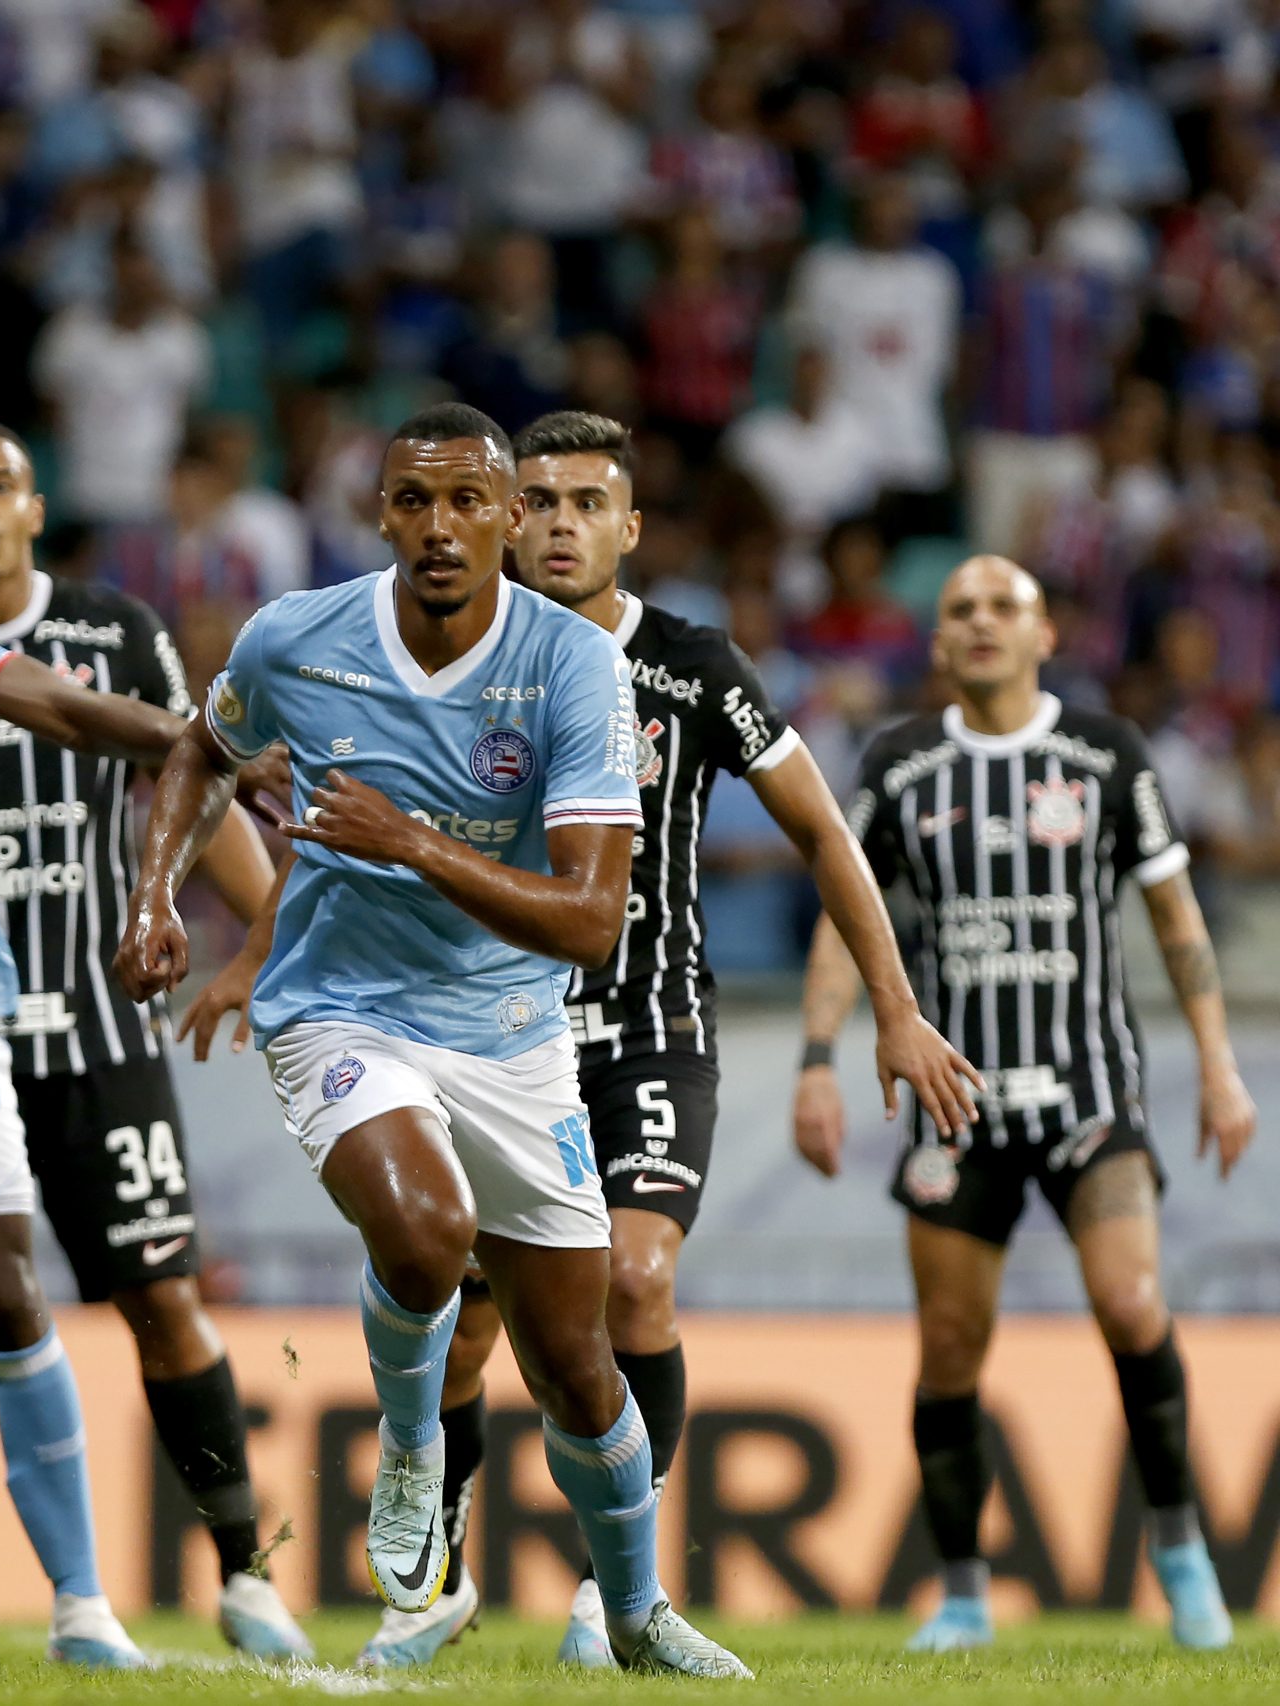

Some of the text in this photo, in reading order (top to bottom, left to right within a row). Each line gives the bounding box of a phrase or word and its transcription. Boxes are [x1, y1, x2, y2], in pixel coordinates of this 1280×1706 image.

[298, 665, 371, 688] acelen
[626, 658, 703, 707] ixbet
[729, 701, 767, 762] bmg
[636, 1080, 676, 1139] 5
[105, 1119, 187, 1202] 34
[607, 1152, 702, 1188] UniCesumar
